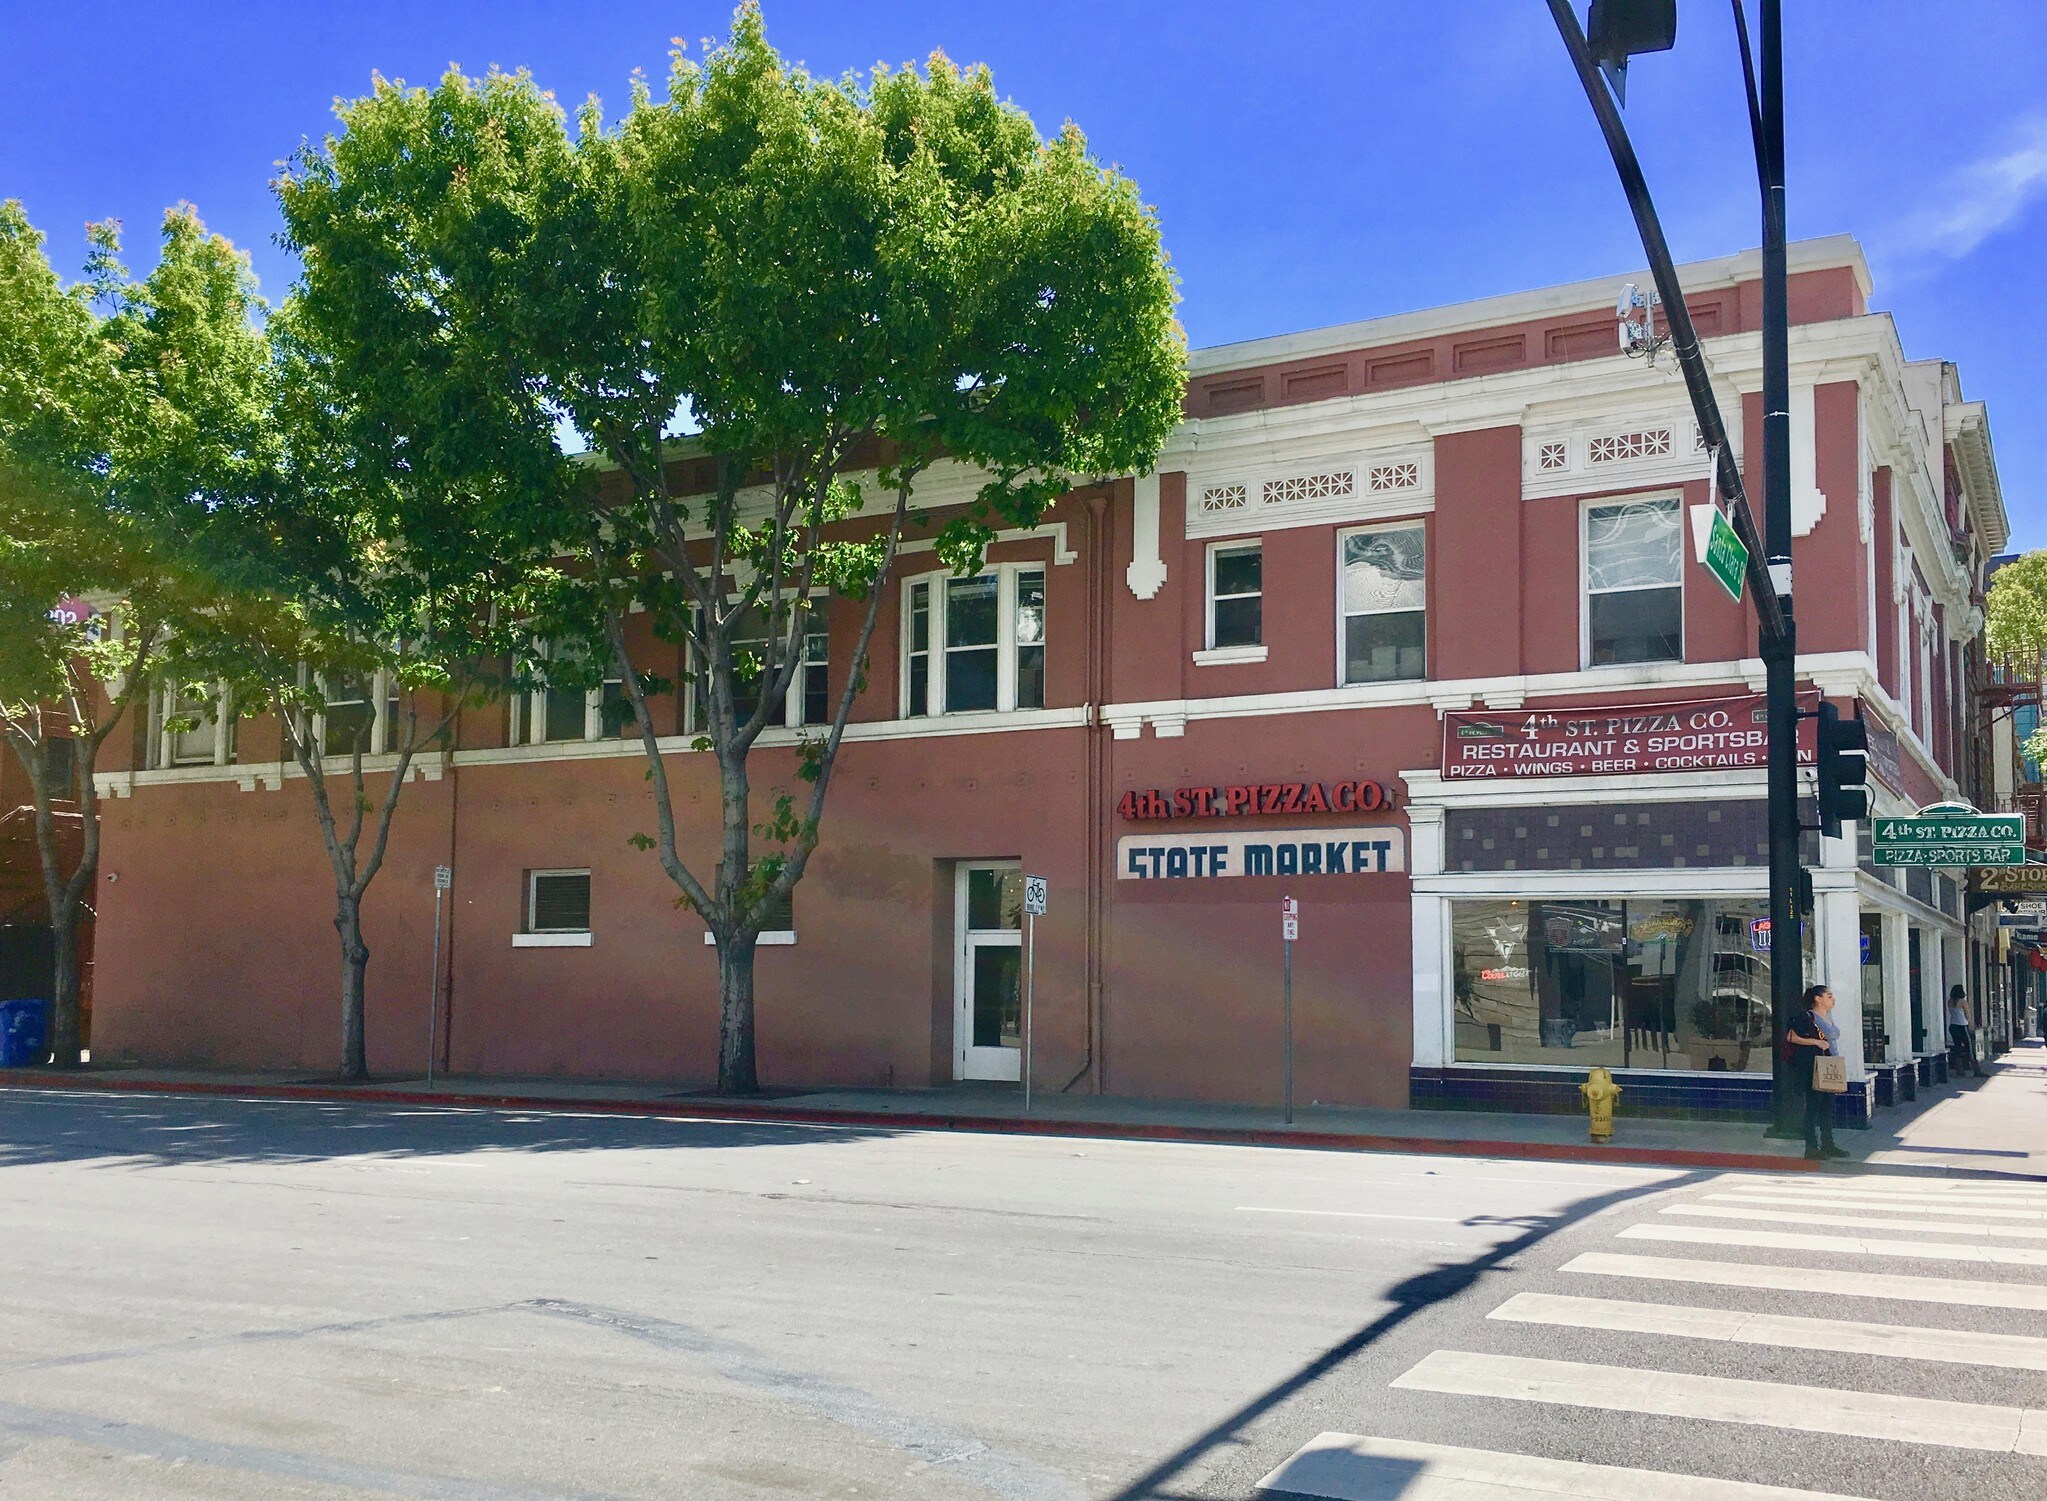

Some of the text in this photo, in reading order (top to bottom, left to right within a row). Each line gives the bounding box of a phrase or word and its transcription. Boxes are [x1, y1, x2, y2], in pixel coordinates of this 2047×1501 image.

[1520, 710, 1734, 740] 4th ST. PIZZA CO.
[1462, 729, 1799, 760] RESTAURANT & SPORTSB
[1450, 751, 1757, 777] PIZZA WINGS BEER COCKTAILS
[1117, 780, 1391, 820] 4th ST. PIZZA CO.
[1882, 822, 2017, 840] 4th ST. PIZZA CO.
[1128, 840, 1391, 878] STATE MARKET
[1984, 849, 2011, 862] BAR
